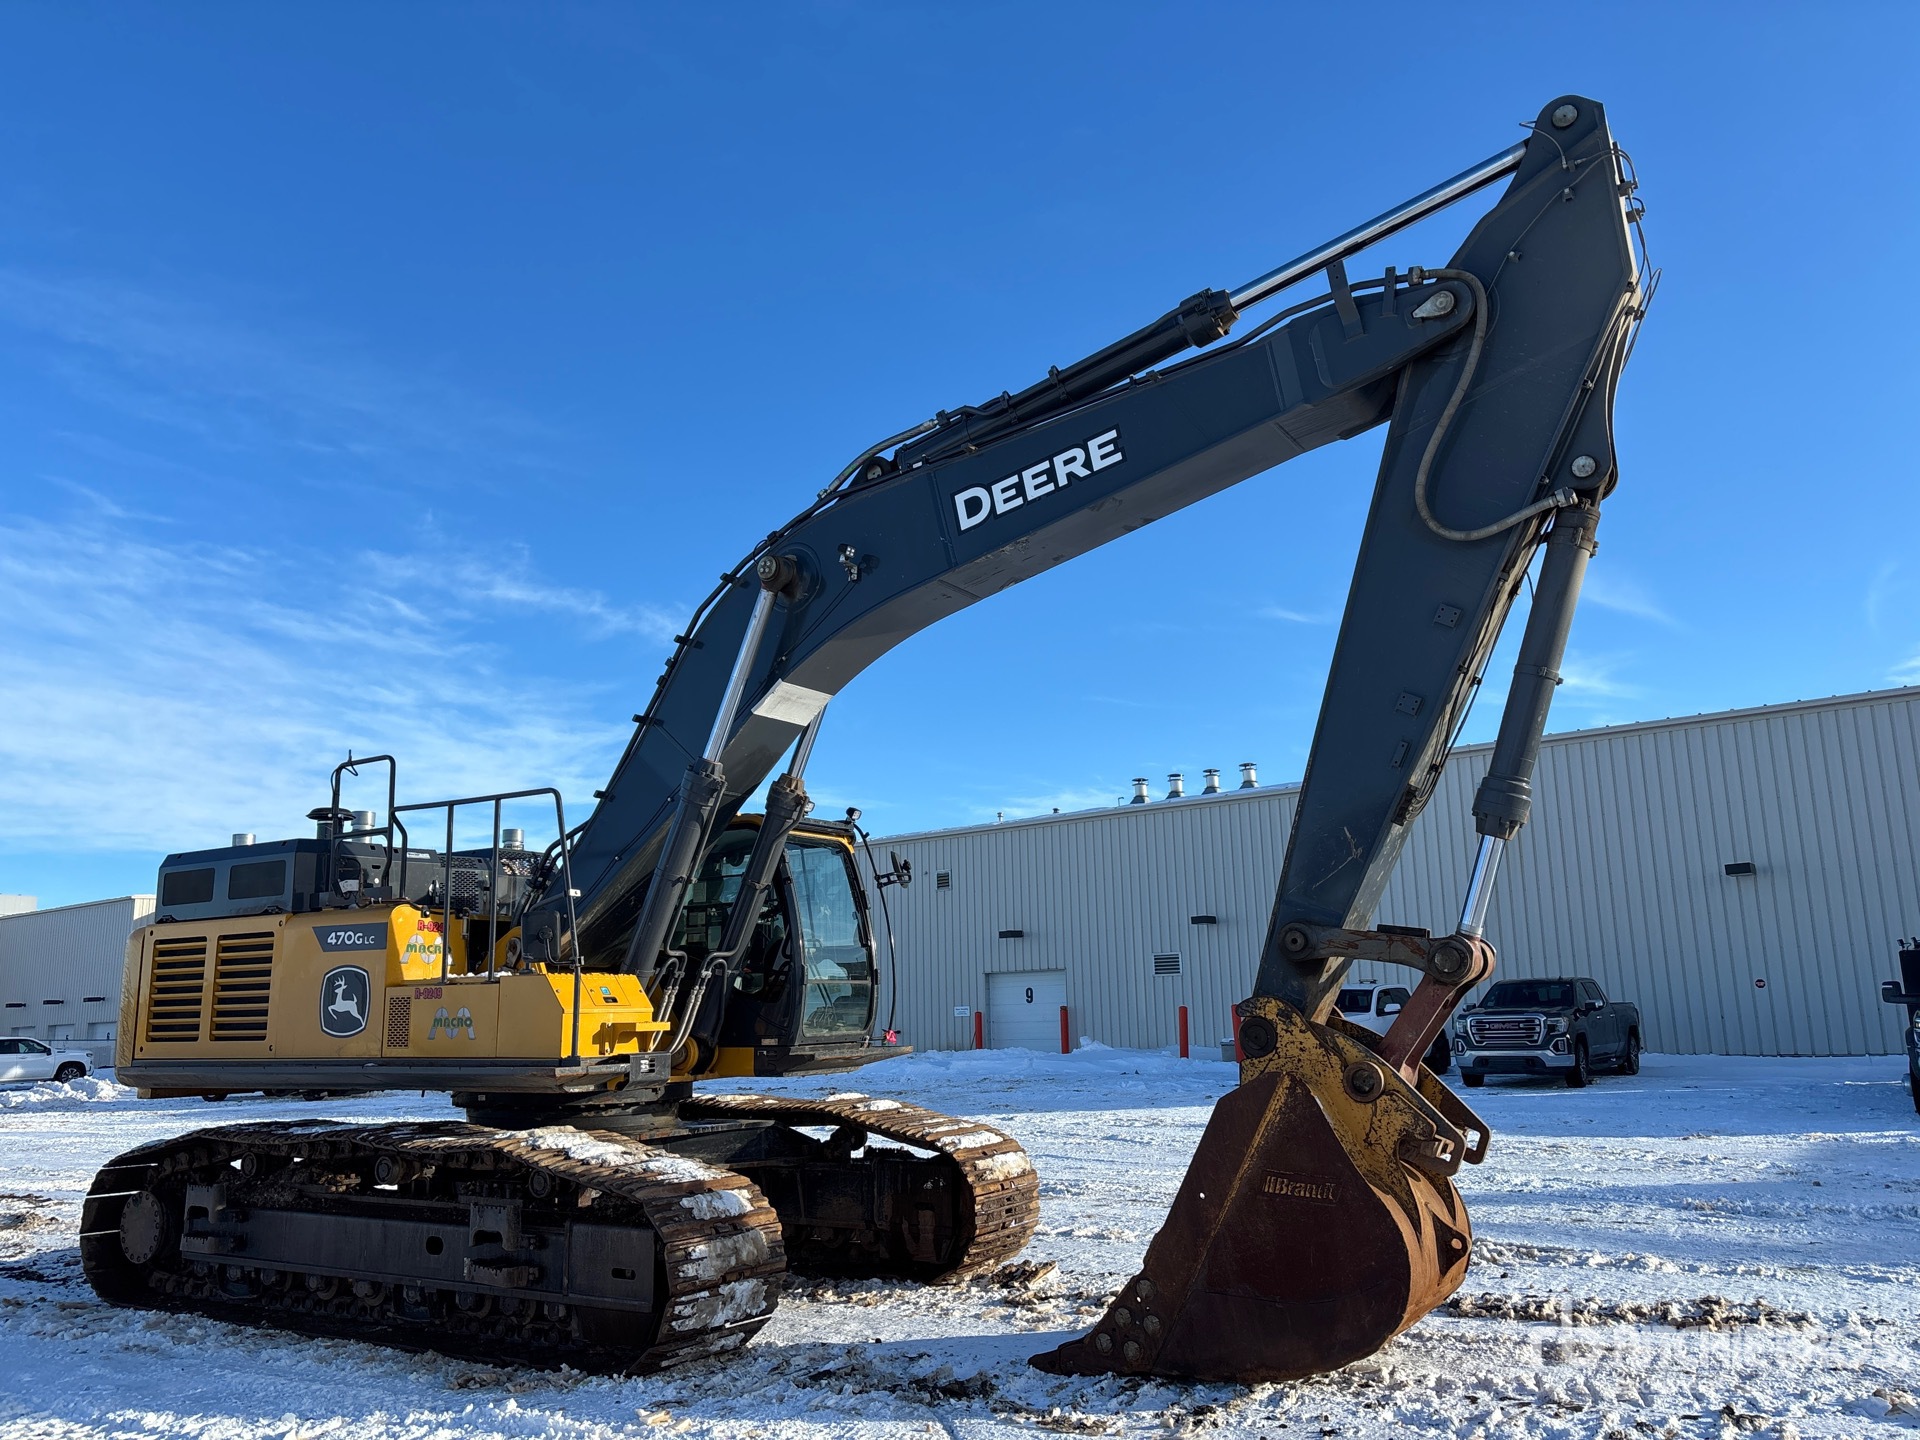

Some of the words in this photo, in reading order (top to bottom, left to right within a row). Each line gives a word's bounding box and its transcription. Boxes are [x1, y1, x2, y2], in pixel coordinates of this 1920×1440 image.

[954, 429, 1122, 531] DEERE
[327, 931, 363, 945] 470G
[364, 936, 375, 944] LC
[414, 987, 443, 1000] R-9249
[1026, 987, 1034, 1004] 9
[433, 1017, 473, 1028] MACRO
